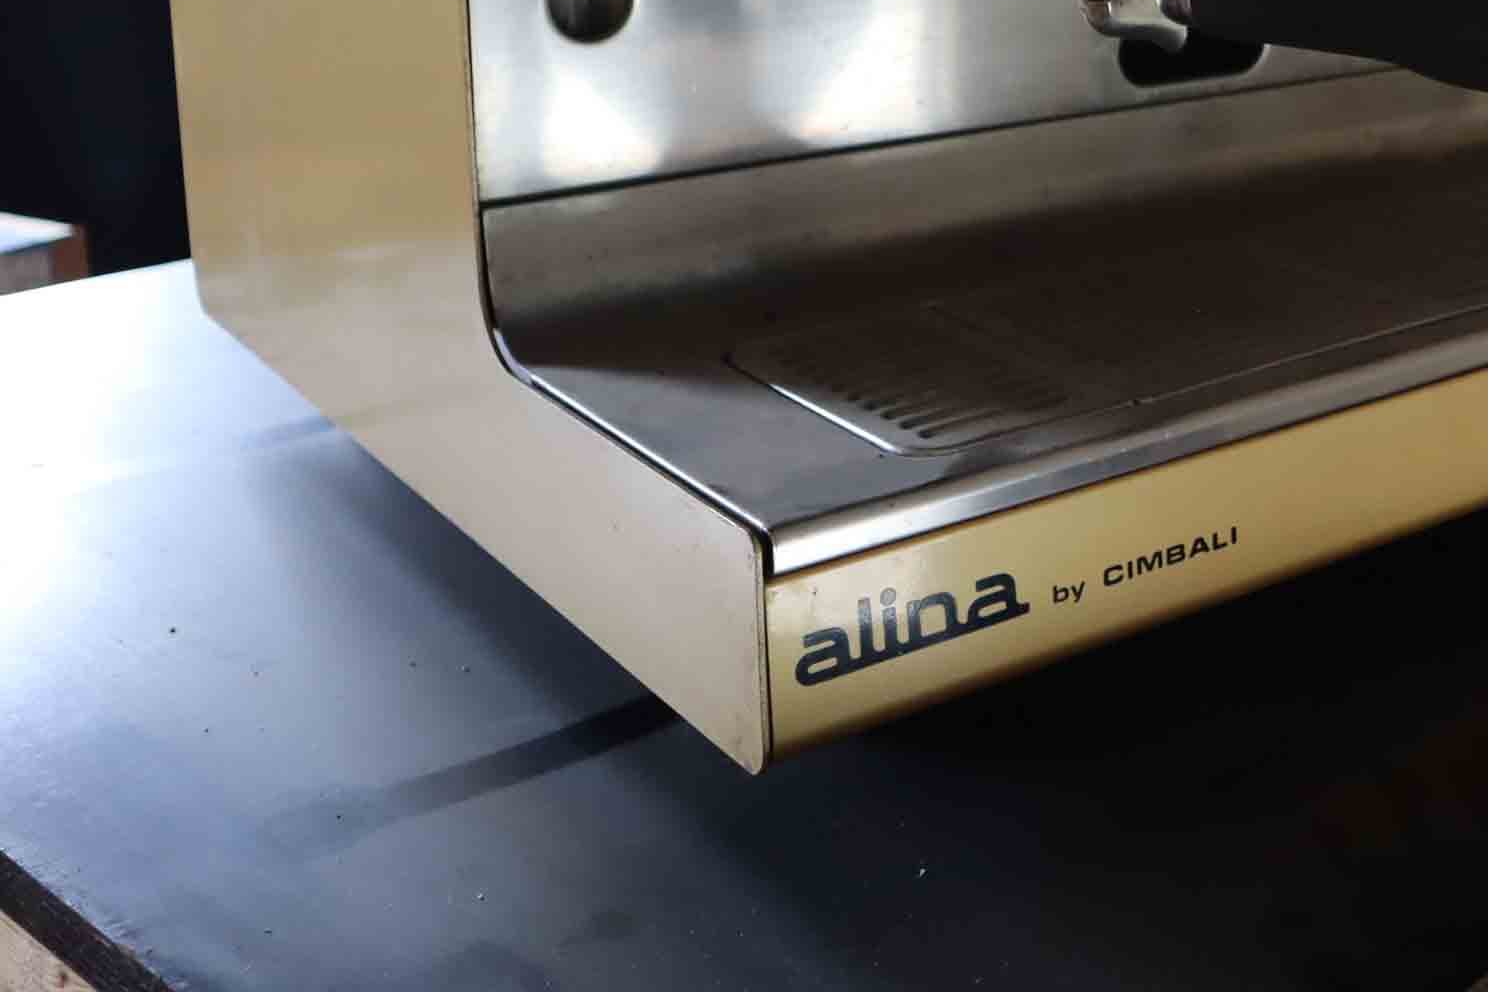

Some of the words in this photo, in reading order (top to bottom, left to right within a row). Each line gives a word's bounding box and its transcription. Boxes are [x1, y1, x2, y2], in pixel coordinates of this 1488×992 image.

[795, 572, 1030, 686] alina
[1053, 581, 1086, 606] by
[1103, 526, 1238, 587] CIMBALI
